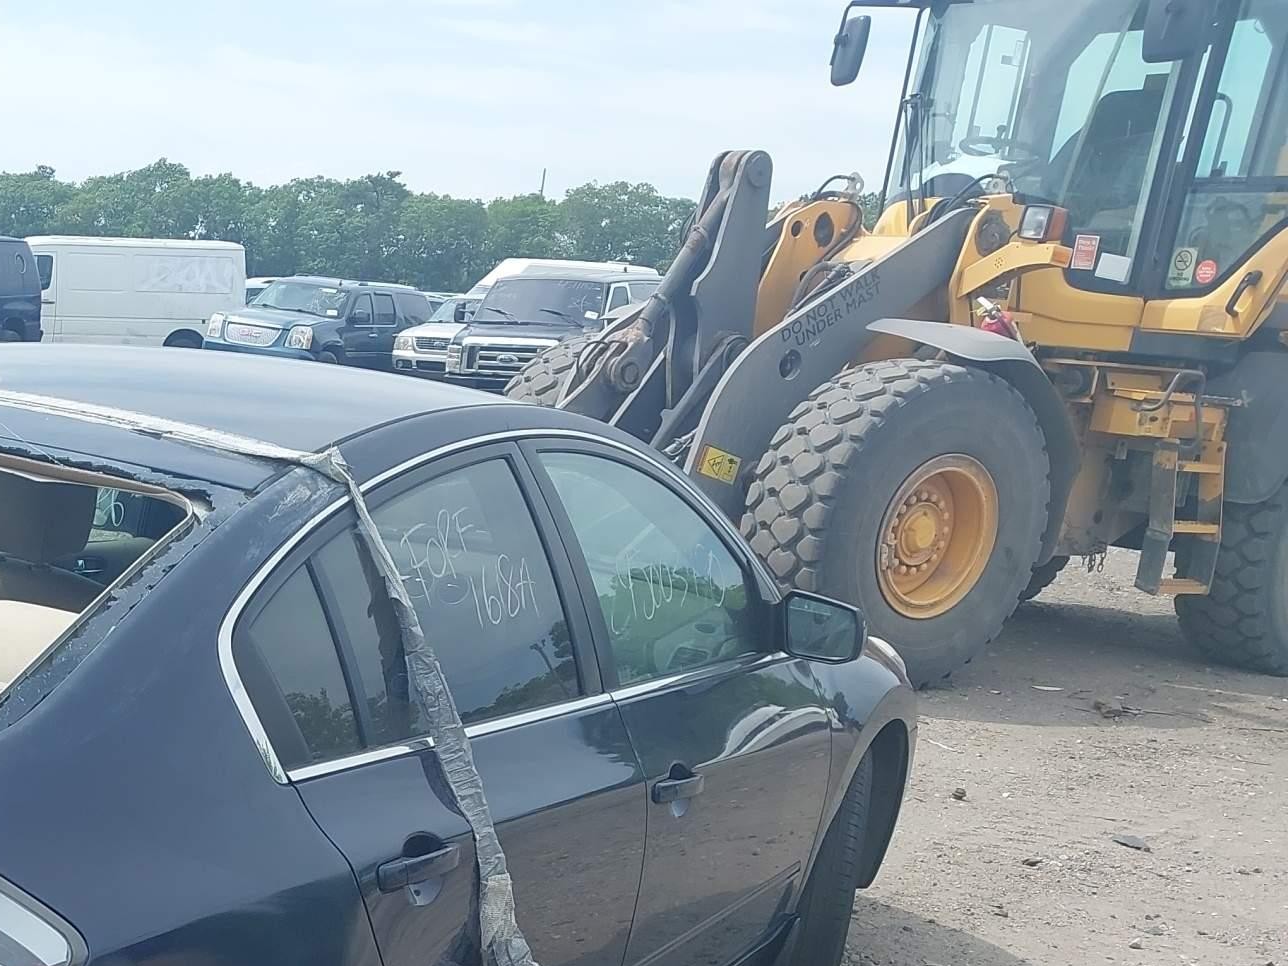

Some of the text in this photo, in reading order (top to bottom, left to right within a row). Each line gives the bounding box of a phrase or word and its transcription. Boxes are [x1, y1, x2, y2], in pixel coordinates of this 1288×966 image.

[781, 321, 802, 342] DO
[807, 298, 836, 325] NOT
[795, 280, 881, 346] UNDER MAST
